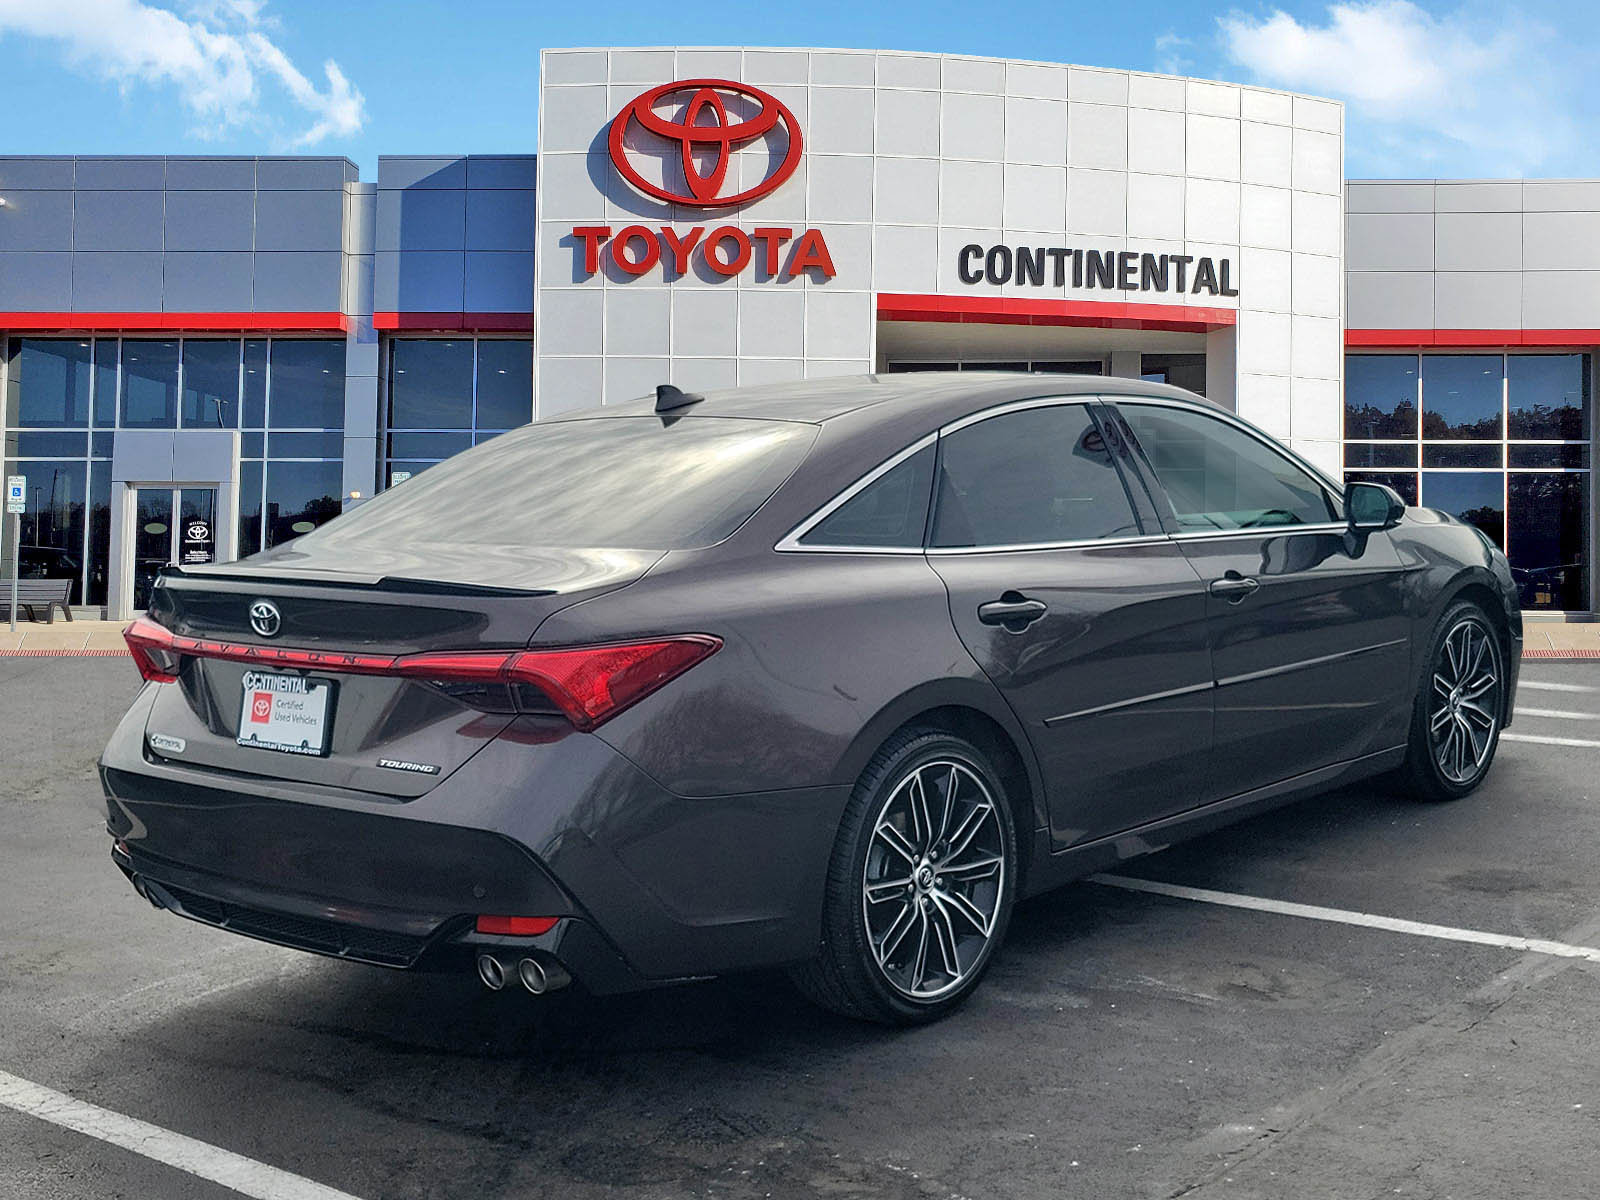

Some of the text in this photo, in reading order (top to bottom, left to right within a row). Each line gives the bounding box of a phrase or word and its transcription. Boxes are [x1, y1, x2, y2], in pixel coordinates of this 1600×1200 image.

[572, 225, 836, 277] TOYOTA
[958, 243, 1239, 297] CONTINENTAL
[193, 640, 358, 664] AVALON
[243, 670, 309, 695] CONTINENTAL
[276, 699, 304, 711] Certified
[274, 711, 318, 726] Used Vehicles
[237, 737, 321, 756] ContinentalToyota.com
[380, 759, 434, 773] TOURING
